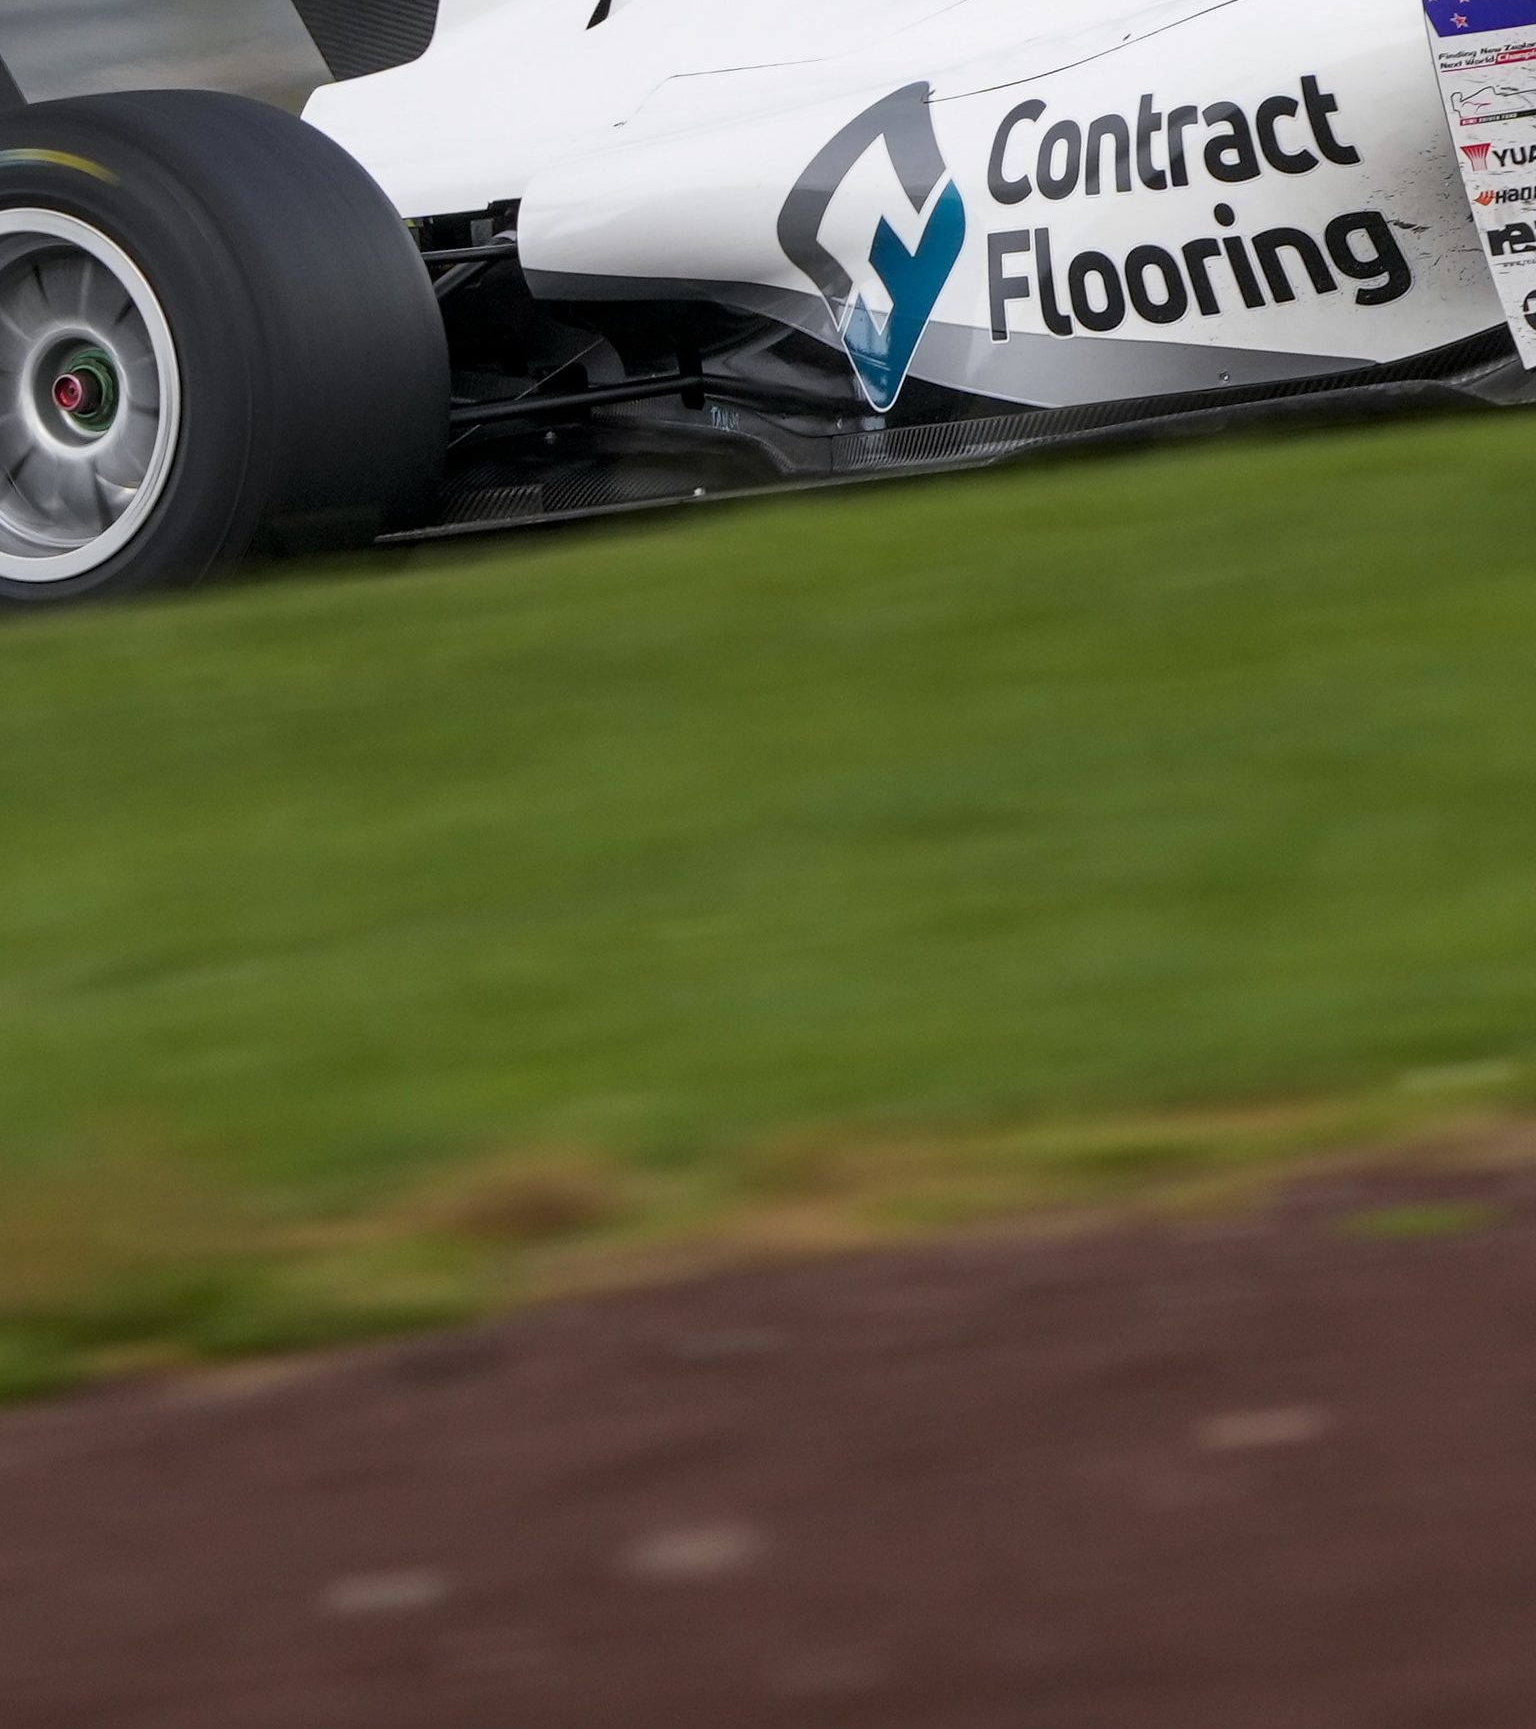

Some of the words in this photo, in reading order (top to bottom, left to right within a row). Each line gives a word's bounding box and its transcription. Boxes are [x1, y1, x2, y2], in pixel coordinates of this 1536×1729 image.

[1438, 50, 1477, 61] Finding
[1480, 47, 1502, 55] New
[1440, 60, 1463, 69] Next
[1465, 55, 1495, 66] World
[986, 73, 1359, 205] Contract
[986, 202, 1412, 342] Flooring
